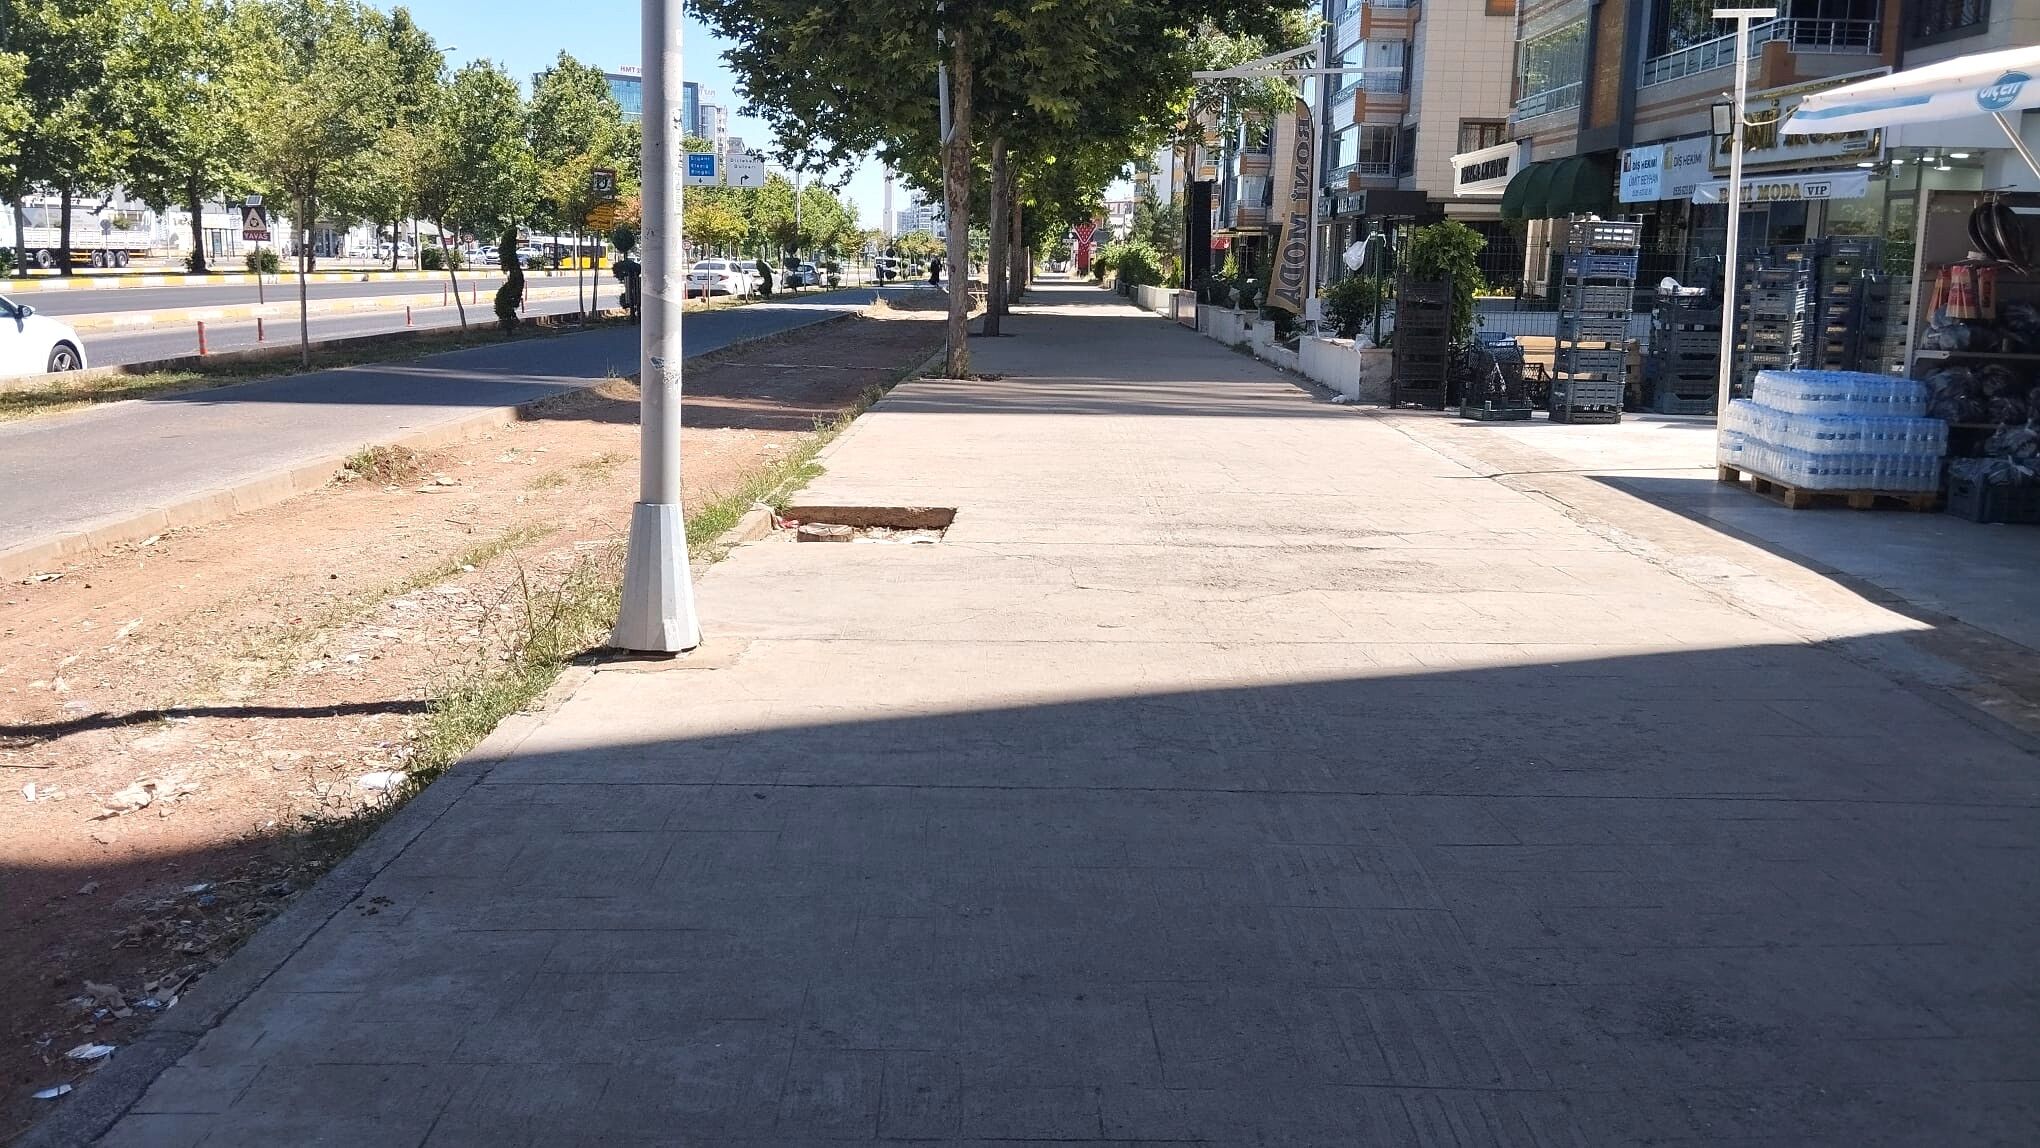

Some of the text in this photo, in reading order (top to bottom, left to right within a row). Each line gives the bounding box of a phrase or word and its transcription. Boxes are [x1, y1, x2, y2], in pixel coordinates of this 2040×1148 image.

[1673, 154, 1683, 169] DİŞ
[1757, 183, 1802, 200] MODA
[1807, 185, 1827, 196] VIP
